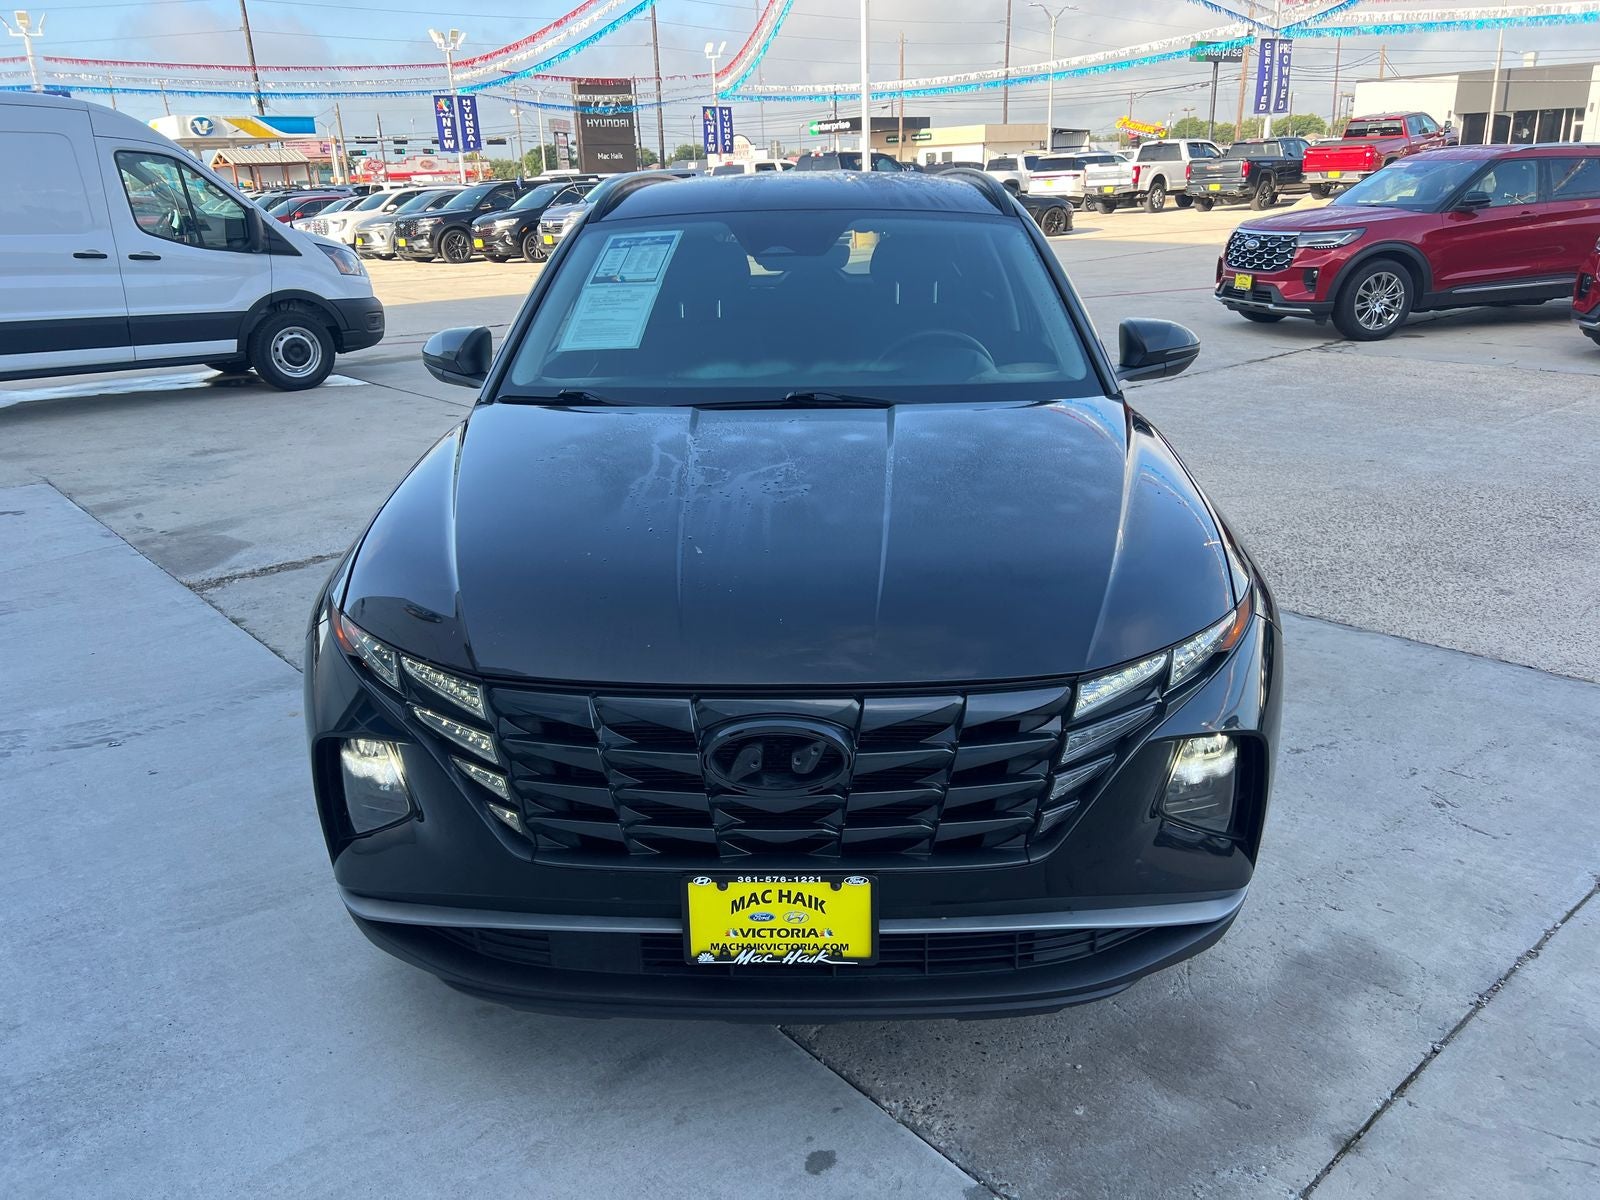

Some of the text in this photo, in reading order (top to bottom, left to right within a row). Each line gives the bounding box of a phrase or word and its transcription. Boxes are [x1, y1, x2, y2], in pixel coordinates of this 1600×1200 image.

[1280, 43, 1292, 54] PRE
[1259, 42, 1271, 110] CERTIFIED
[1278, 55, 1290, 109] OWNED
[442, 117, 455, 149] NEW
[462, 99, 476, 148] HYUNDAI
[586, 118, 630, 128] HYUNDAI
[722, 109, 731, 152] HYUNDAI
[811, 121, 851, 133] enterprise
[706, 124, 716, 152] NEW
[730, 889, 827, 915] MAC HAIK
[739, 927, 820, 939] VICTORIA
[710, 942, 849, 952] MACHAIKVICTORIA.COM
[735, 949, 838, 965] Mac Haik
